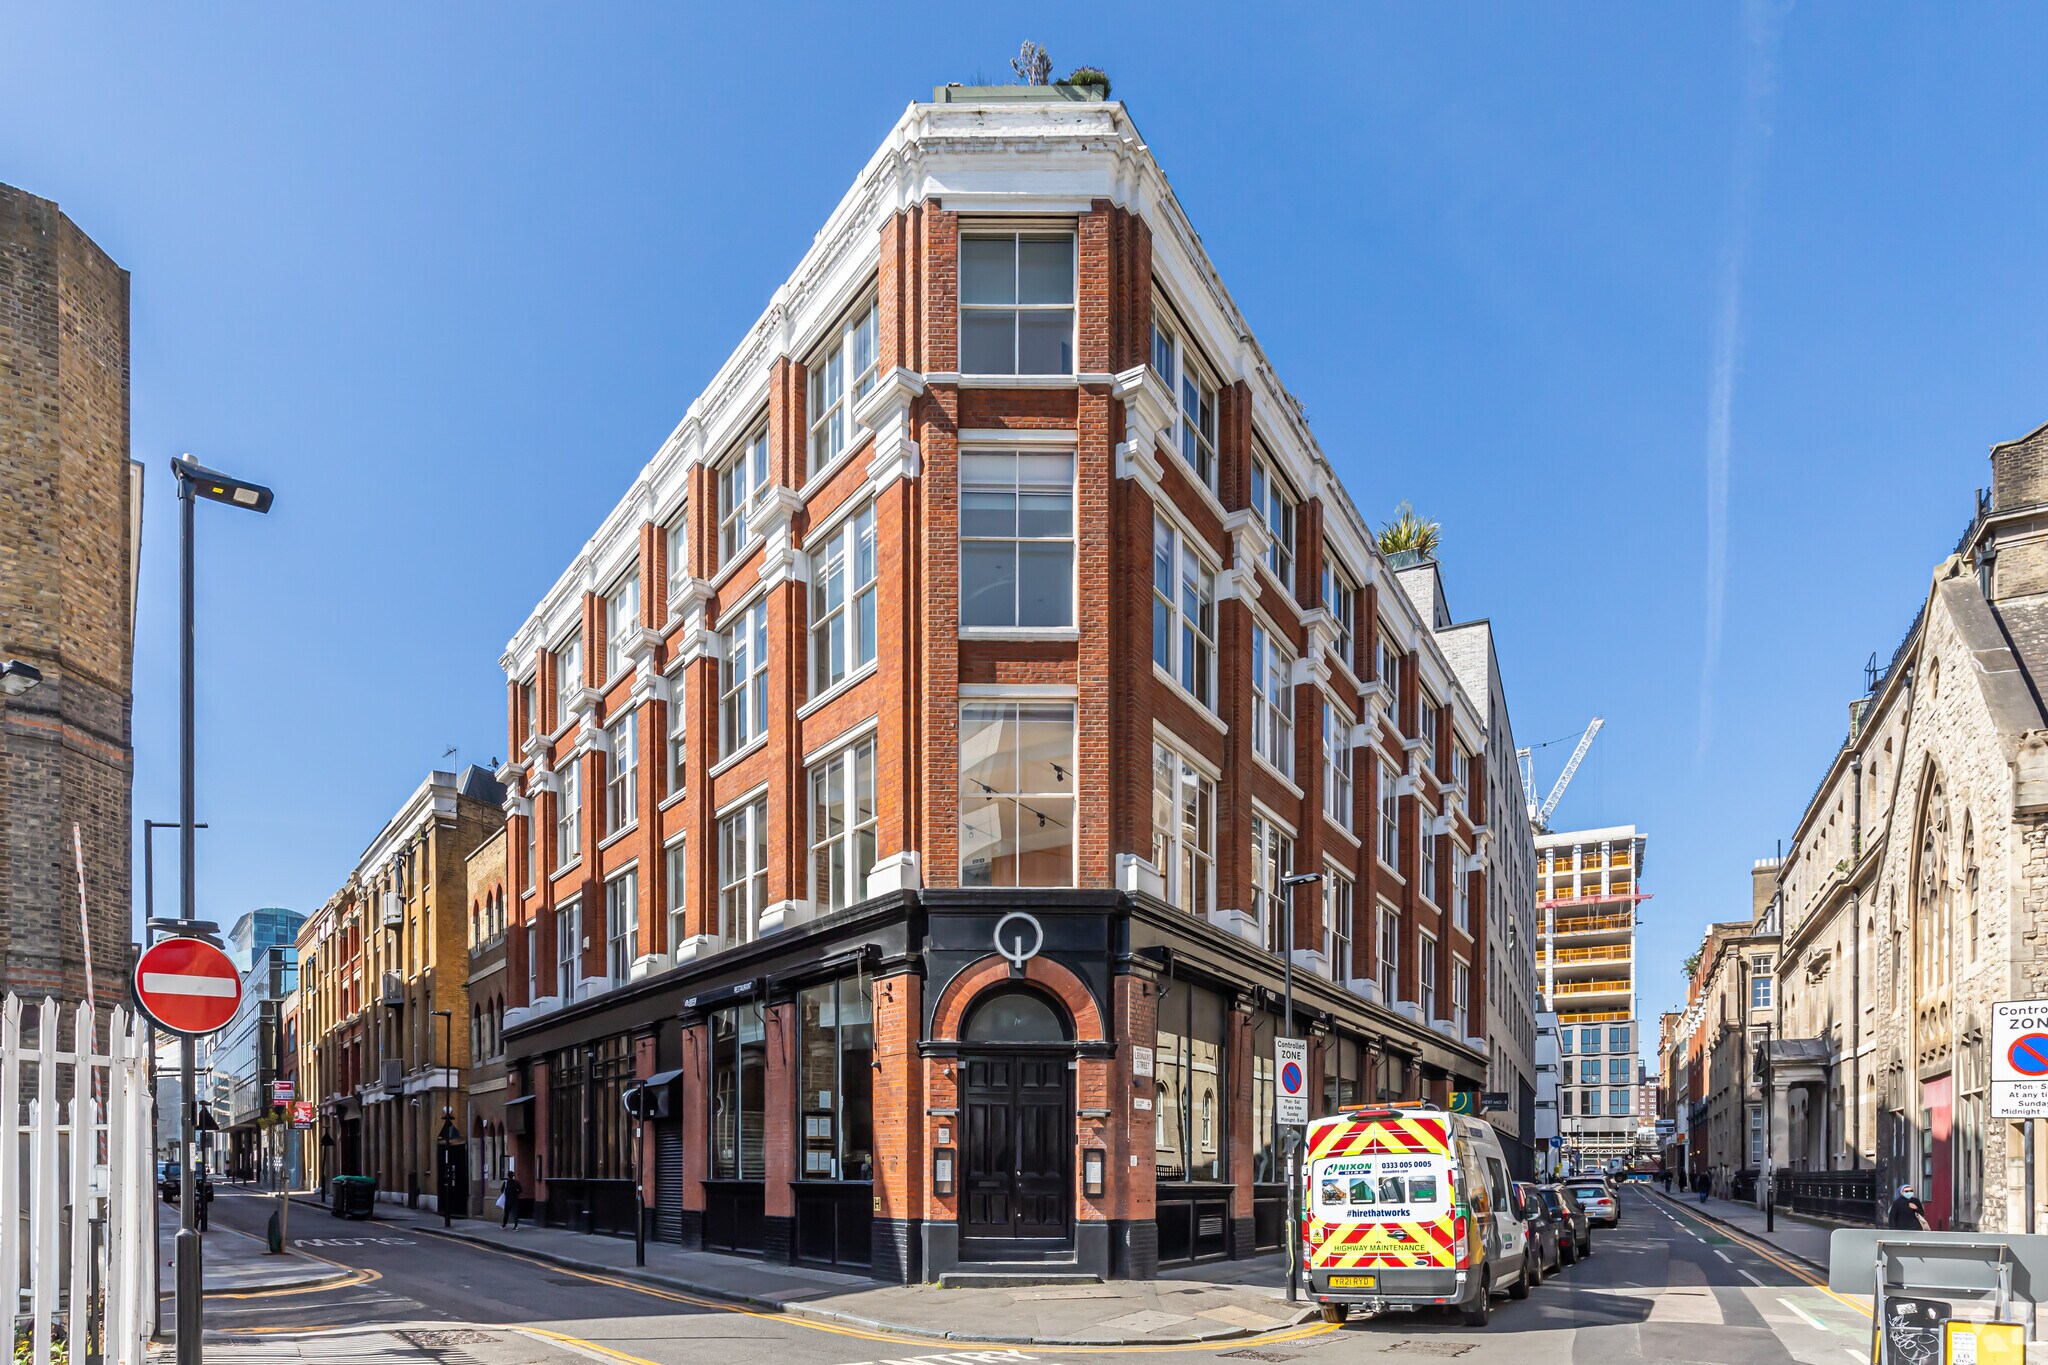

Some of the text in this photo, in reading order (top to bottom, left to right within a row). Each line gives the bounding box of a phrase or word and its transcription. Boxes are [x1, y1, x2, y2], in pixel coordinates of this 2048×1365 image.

[1999, 1005, 2048, 1016] Contro
[1277, 1040, 1305, 1050] Controlled
[1134, 1051, 1151, 1062] LEONARD
[1281, 1050, 1301, 1060] ZONE
[1136, 1060, 1150, 1070] STREET
[2001, 1108, 2040, 1116] Midnight
[1338, 1162, 1372, 1171] NIXON
[1381, 1160, 1432, 1169] 0333 005 0005
[1346, 1208, 1411, 1218] #hirethatworks
[1334, 1244, 1426, 1252] HIGHWAY MAINTENANCE
[1335, 1277, 1369, 1286] YR21 RYD
